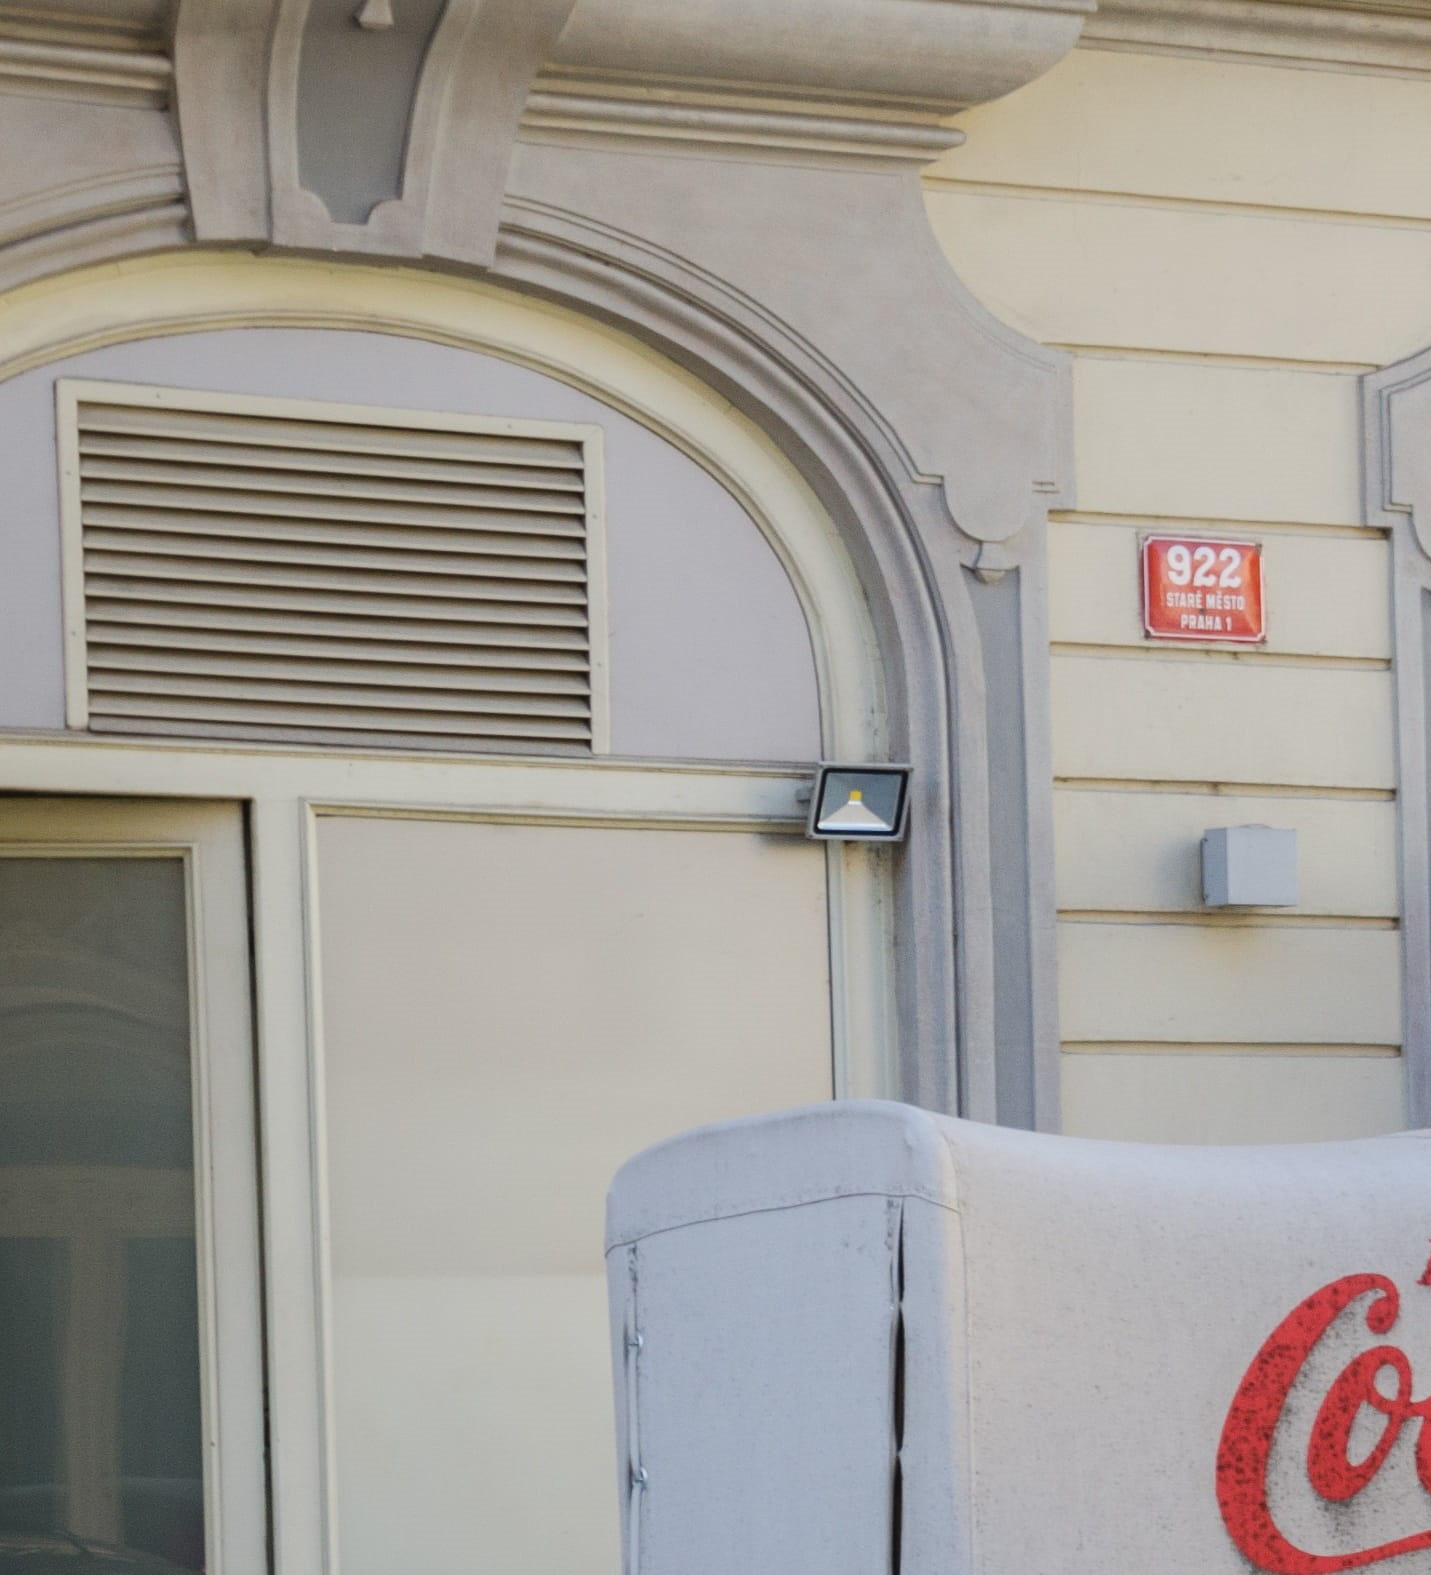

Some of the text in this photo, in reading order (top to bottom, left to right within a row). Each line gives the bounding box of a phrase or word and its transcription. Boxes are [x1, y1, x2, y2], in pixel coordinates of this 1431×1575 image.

[1166, 544, 1243, 588] 922
[1166, 591, 1246, 611] STARÉ MĚSTO
[1180, 614, 1232, 631] PRAHA 1
